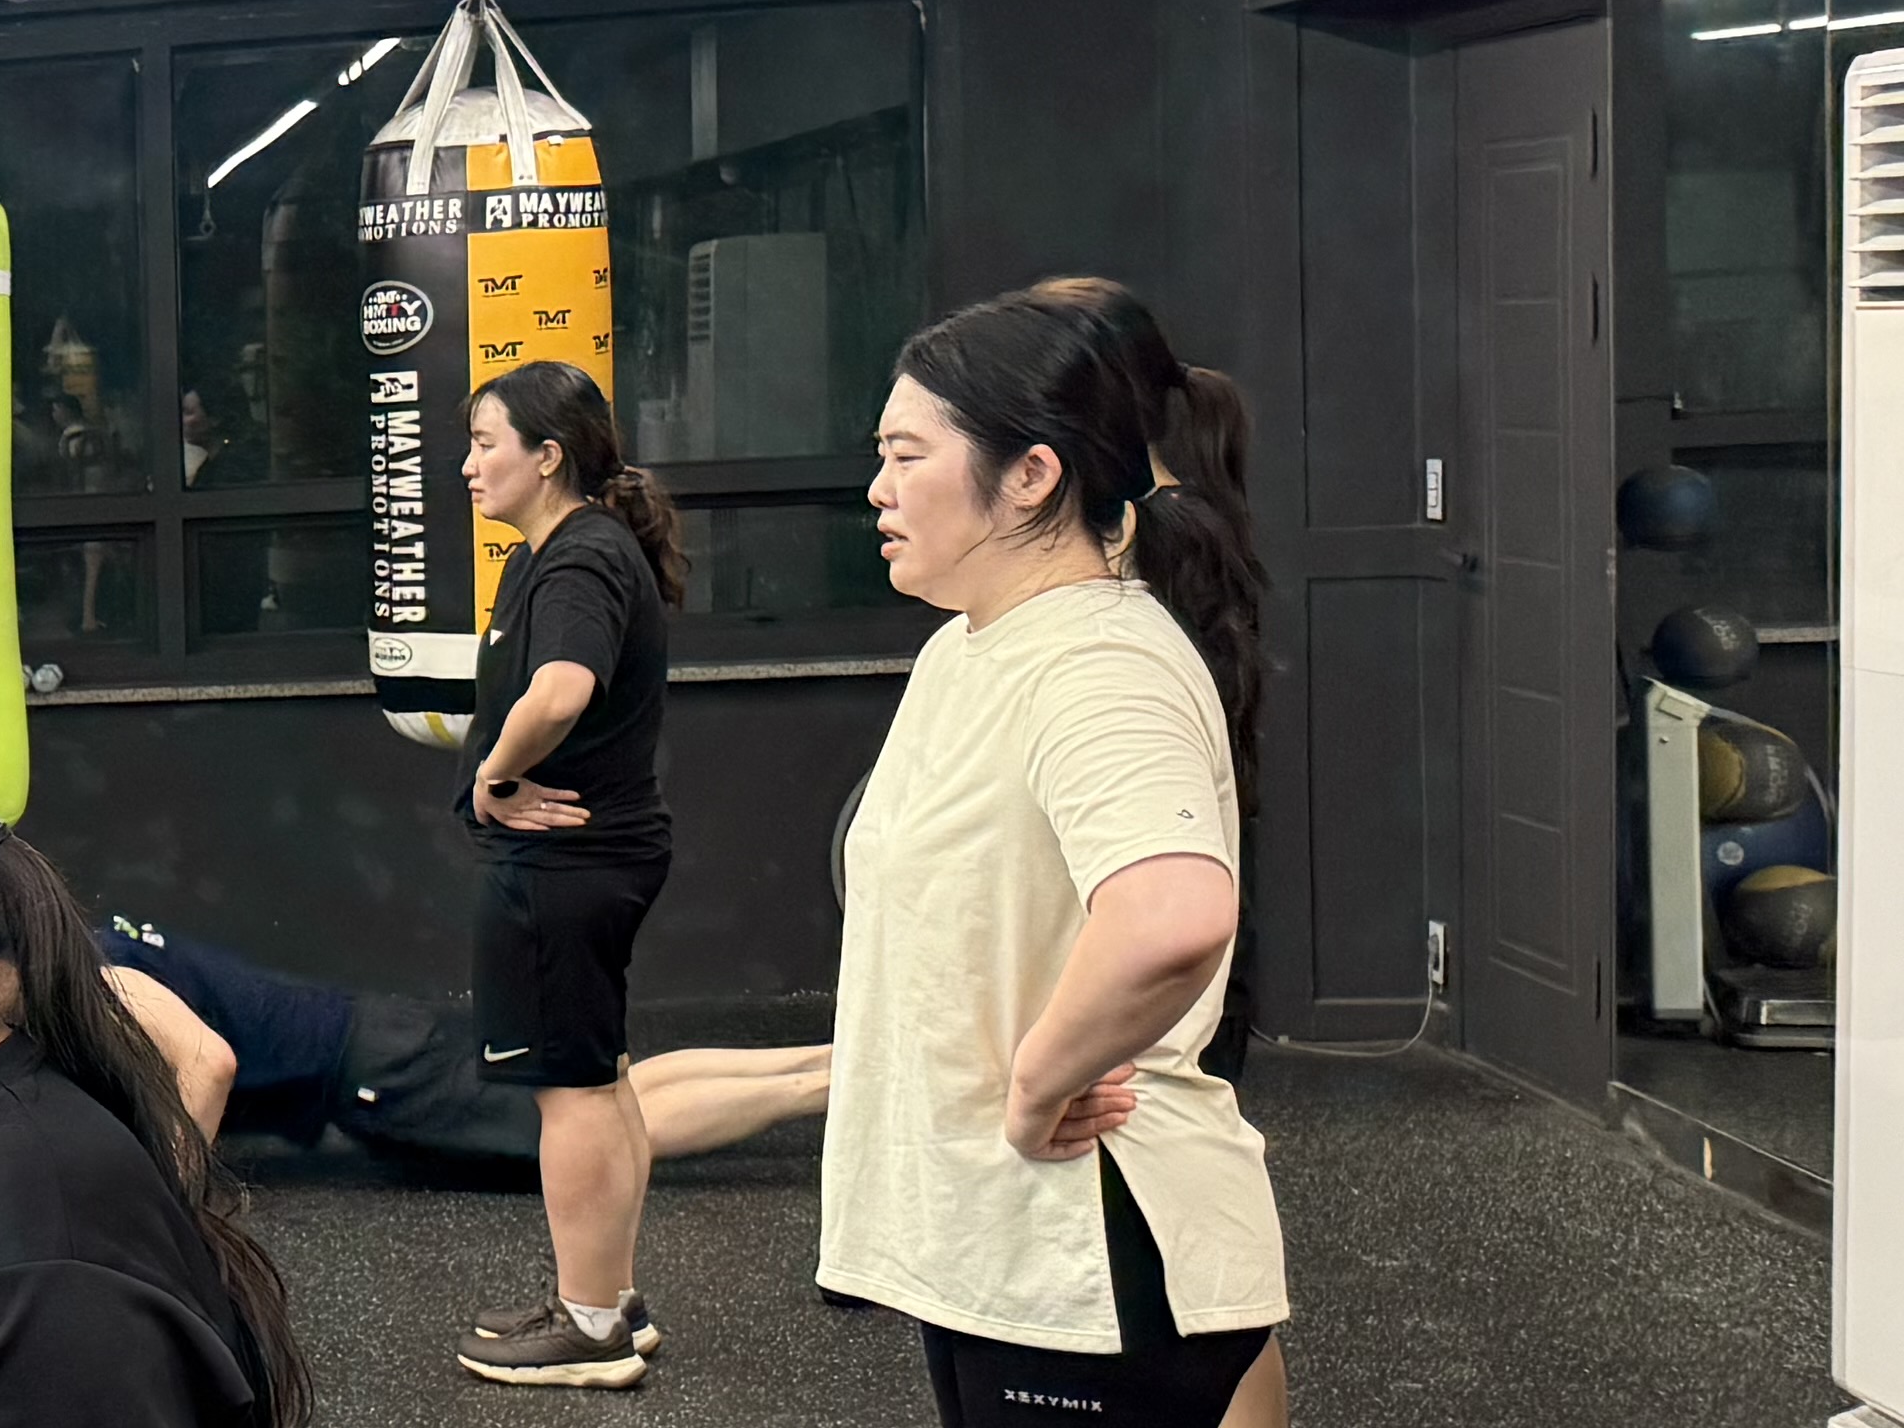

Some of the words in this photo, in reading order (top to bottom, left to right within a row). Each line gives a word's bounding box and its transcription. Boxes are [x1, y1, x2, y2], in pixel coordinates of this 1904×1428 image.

[478, 274, 523, 293] TMT
[533, 309, 571, 326] TMT
[479, 341, 524, 359] TMT
[370, 413, 392, 619] PROMOTIONS
[387, 410, 428, 624] MAYWEATHER
[1004, 1388, 1103, 1413] XEXYMIX
